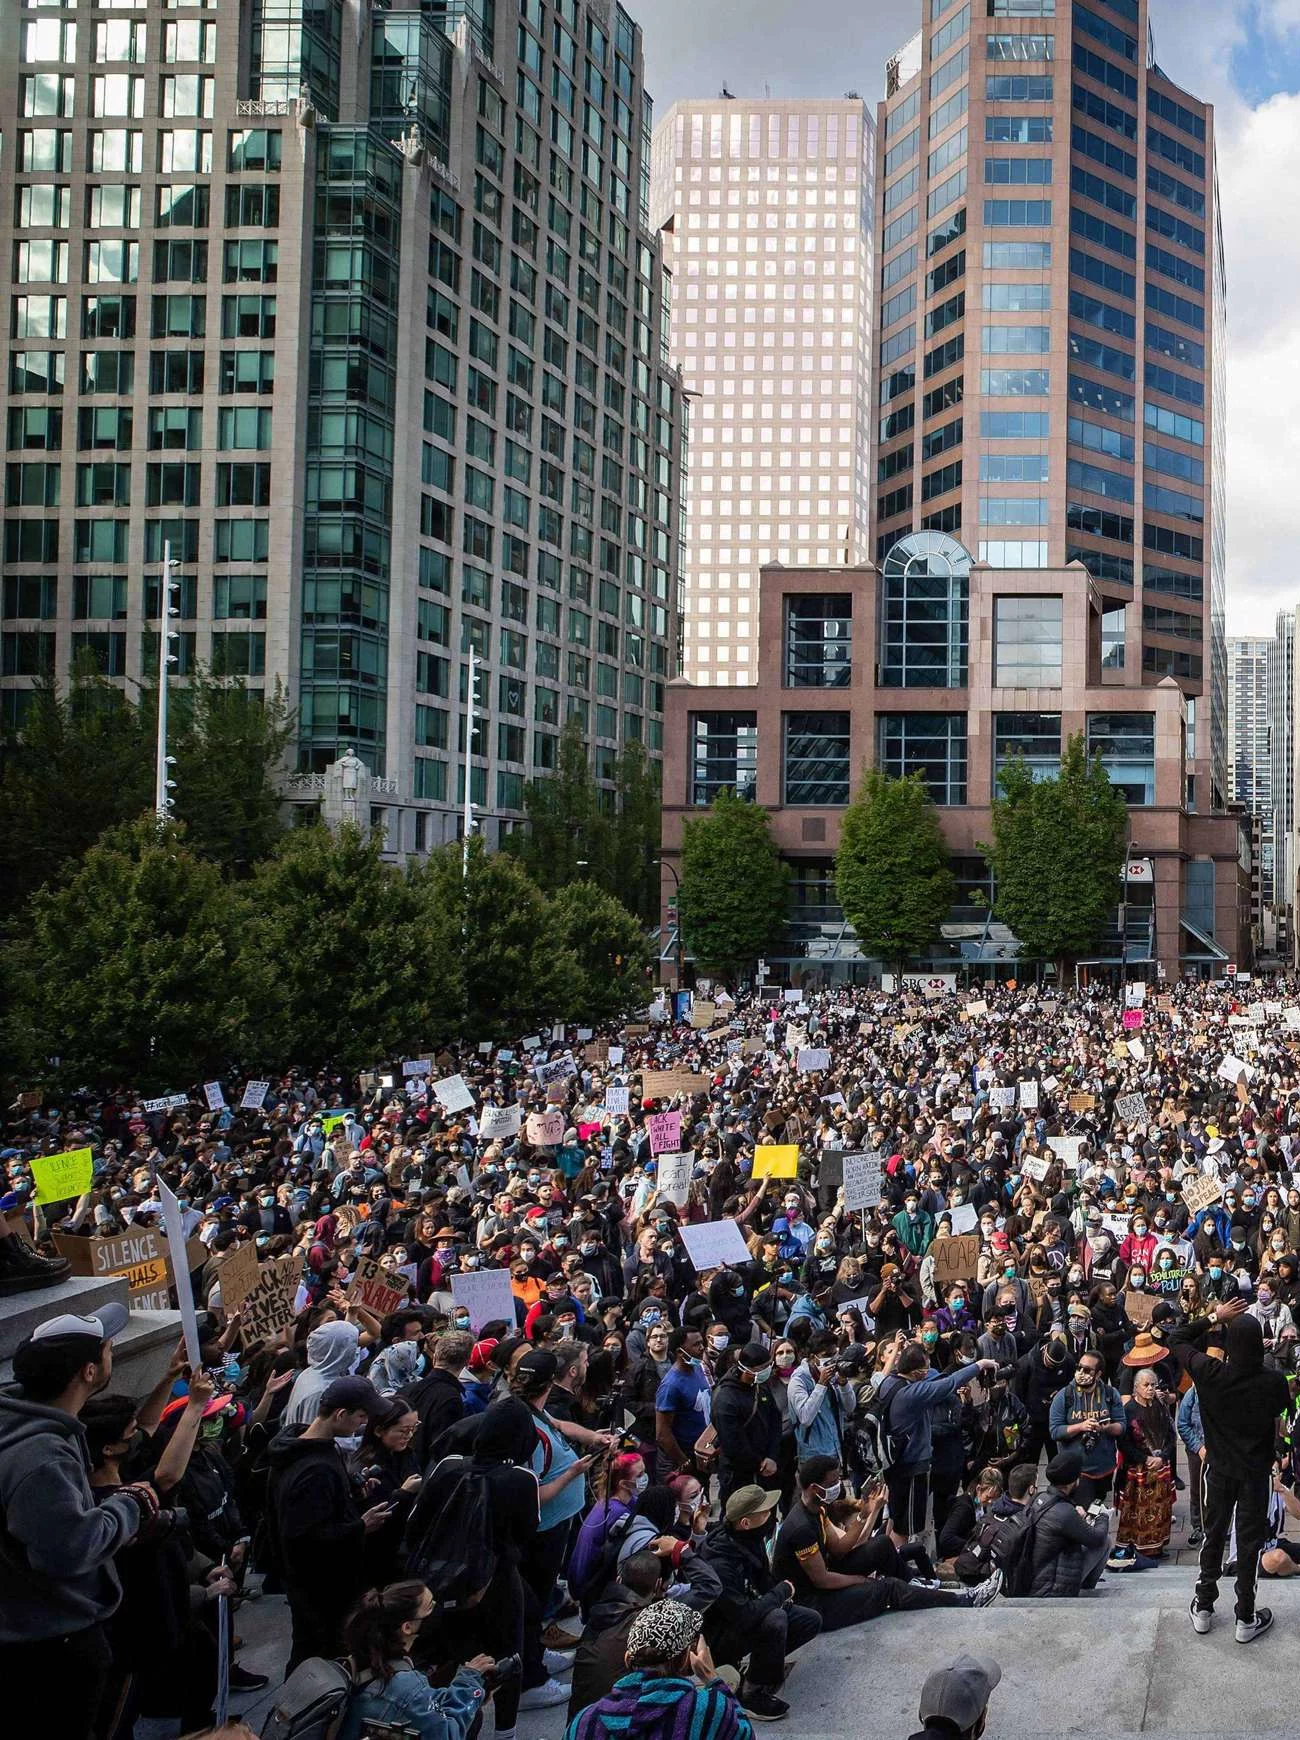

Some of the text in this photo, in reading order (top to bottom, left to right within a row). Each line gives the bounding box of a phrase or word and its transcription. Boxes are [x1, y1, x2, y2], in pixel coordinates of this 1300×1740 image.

[608, 1089, 626, 1097] BLACK
[608, 1097, 626, 1105] LIVES
[1120, 1095, 1141, 1109] BLACK
[607, 1105, 628, 1114] MATTER
[1123, 1104, 1143, 1117] LIVES
[654, 1123, 675, 1133] WHITE
[655, 1132, 668, 1141] ALL
[659, 1139, 680, 1149] FIGHT
[674, 1156, 687, 1167] I
[1182, 1189, 1195, 1201] NO
[1188, 1184, 1220, 1210] NO PEACE
[98, 1234, 159, 1272] SILENCE
[937, 1240, 977, 1270] ACAB
[1132, 1249, 1149, 1257] CAN
[283, 1261, 295, 1274] NO
[361, 1261, 378, 1279] 13
[1161, 1281, 1182, 1293] POLI
[243, 1308, 295, 1343] MATTER
